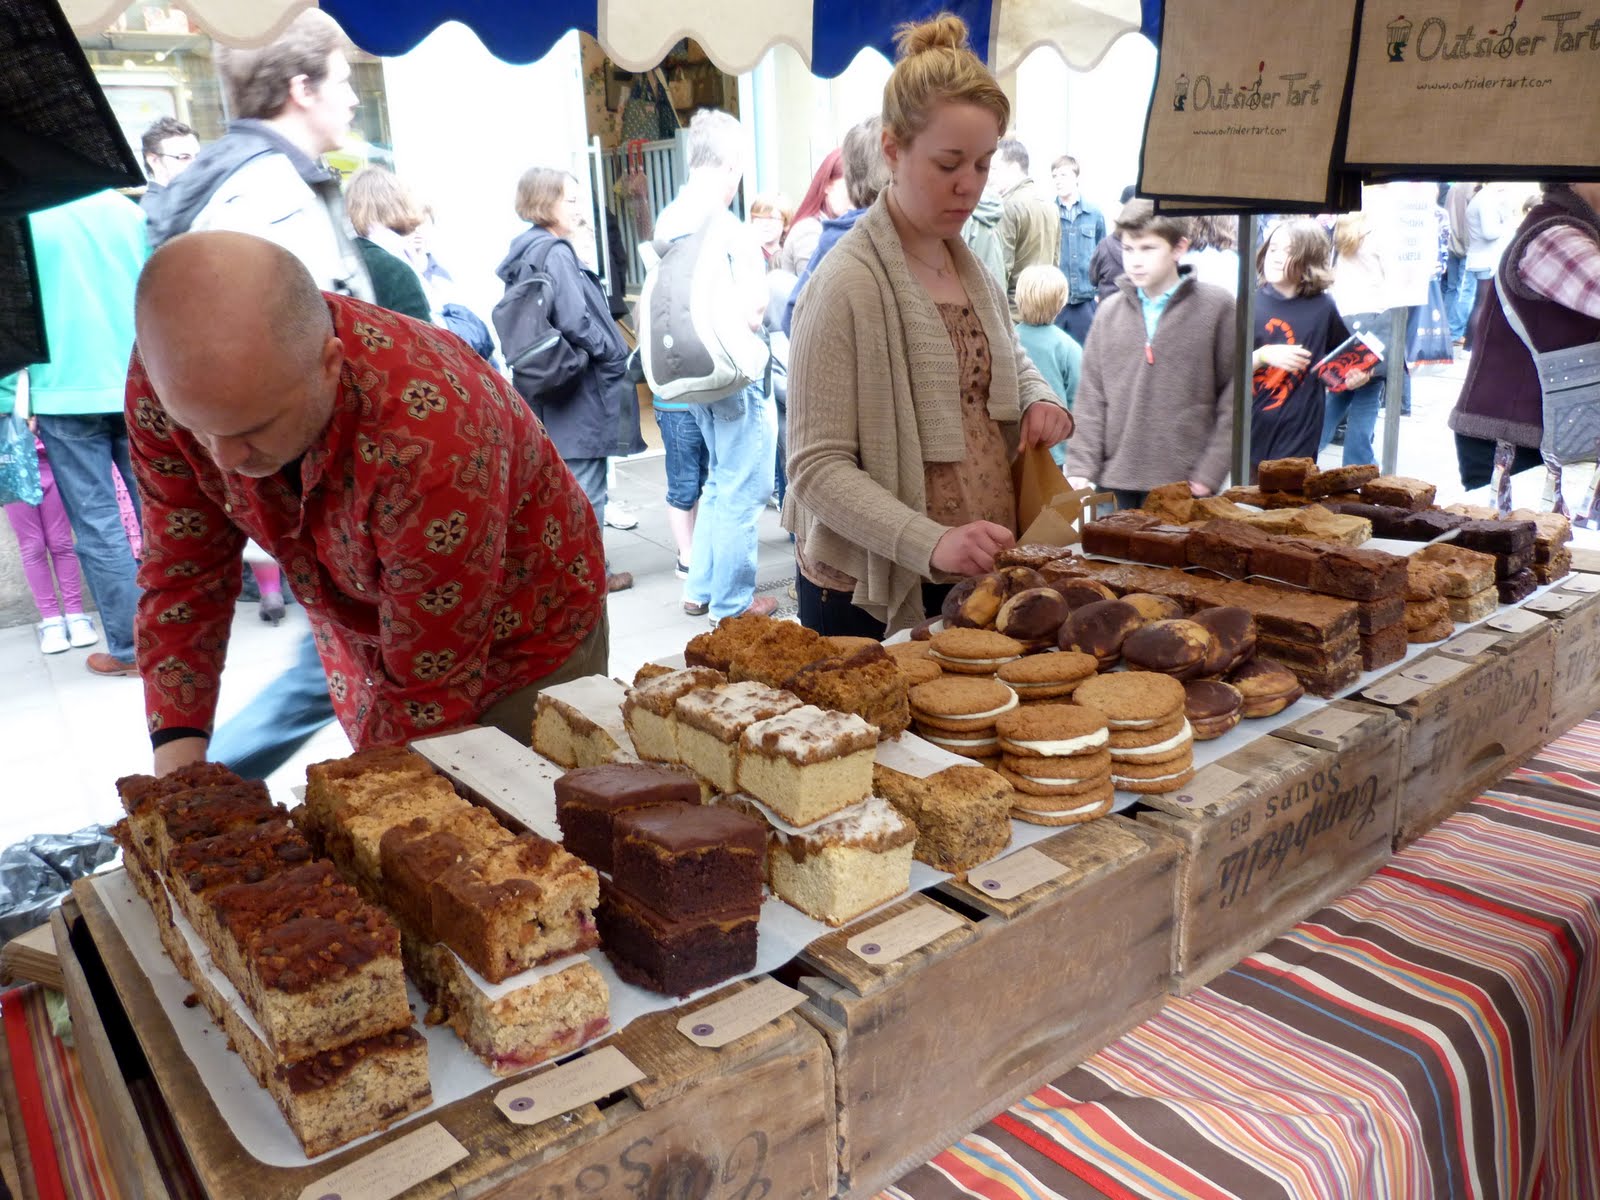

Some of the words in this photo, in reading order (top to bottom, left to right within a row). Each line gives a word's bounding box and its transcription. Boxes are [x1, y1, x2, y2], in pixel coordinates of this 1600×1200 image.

[1417, 6, 1547, 62] Outsider
[1541, 11, 1600, 54] Tart
[1193, 67, 1280, 111] Outsider
[1279, 73, 1323, 107] Tart
[1416, 75, 1552, 91] www.outsidertart.com
